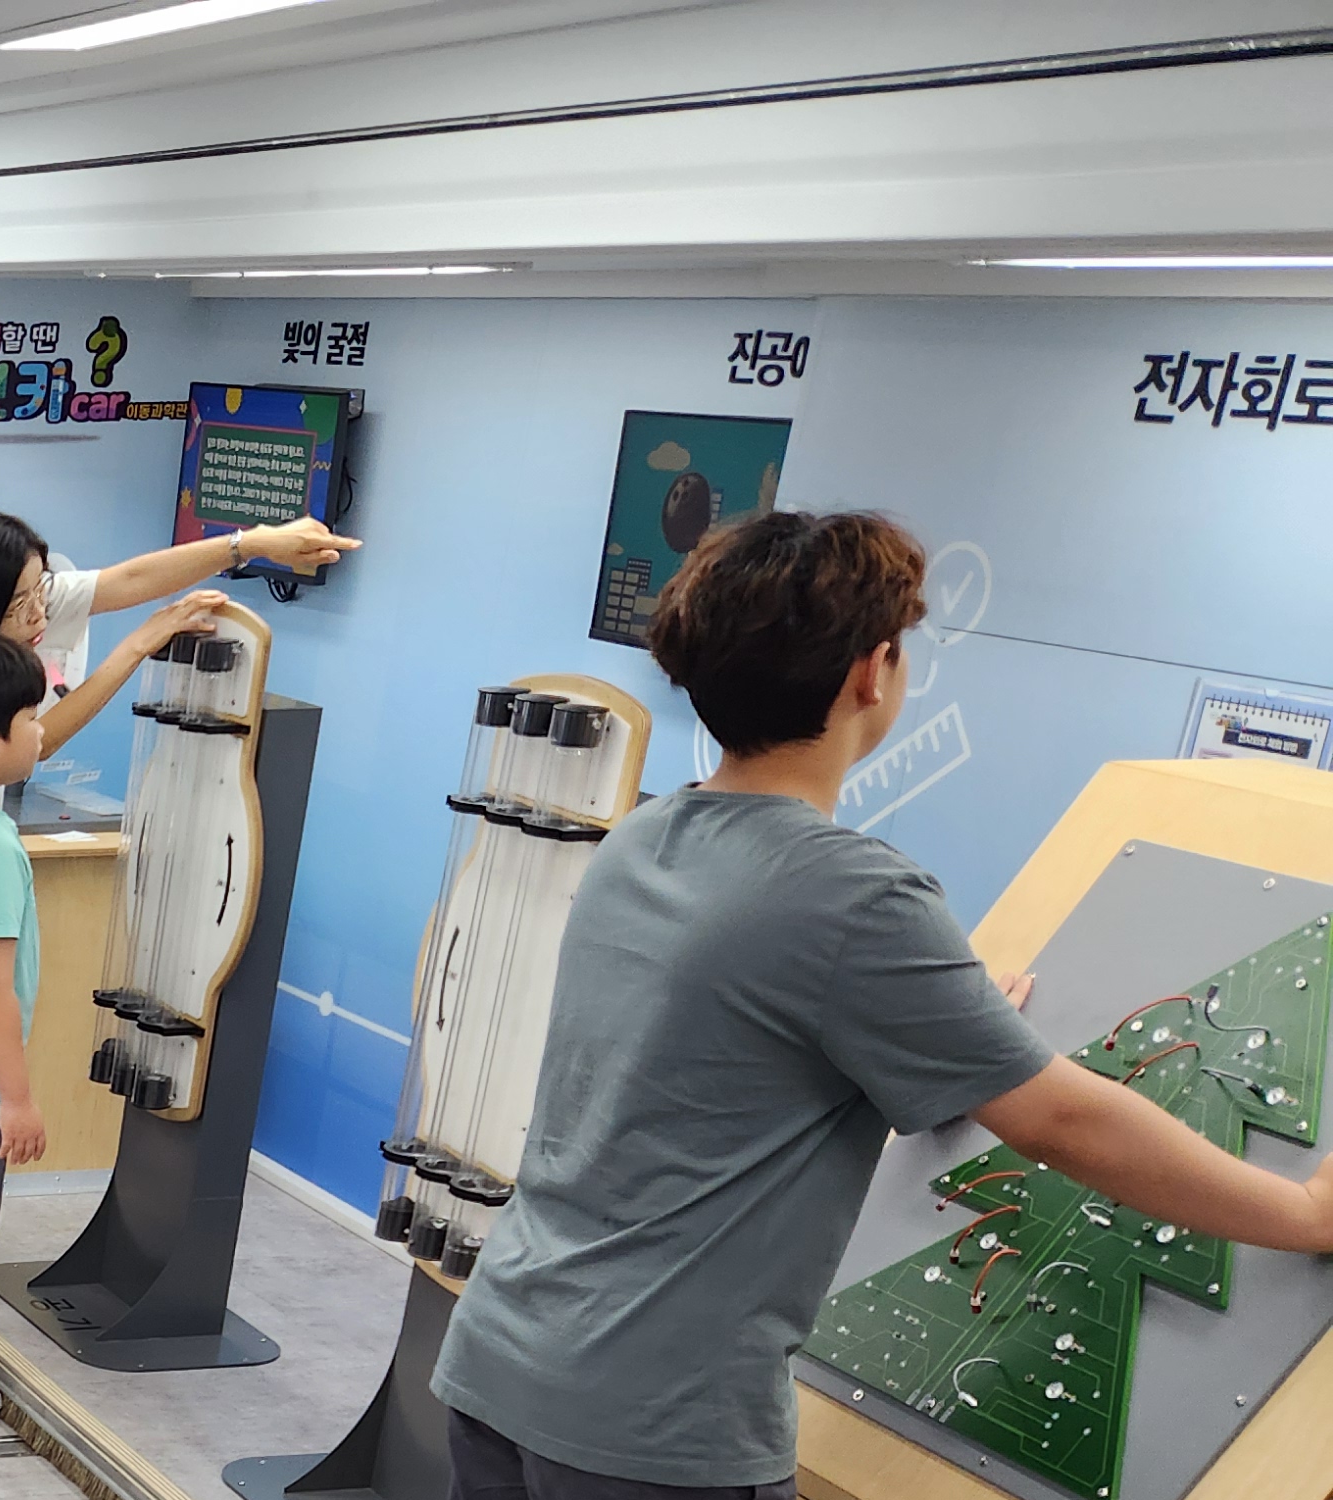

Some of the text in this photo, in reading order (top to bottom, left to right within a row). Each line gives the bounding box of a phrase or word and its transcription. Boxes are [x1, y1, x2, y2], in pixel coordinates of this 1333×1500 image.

[32, 321, 60, 353] 땐
[282, 320, 370, 367] 빛의 굴절
[68, 390, 133, 423] car
[126, 402, 189, 420] 이동과학관
[30, 1297, 102, 1332] 공기
